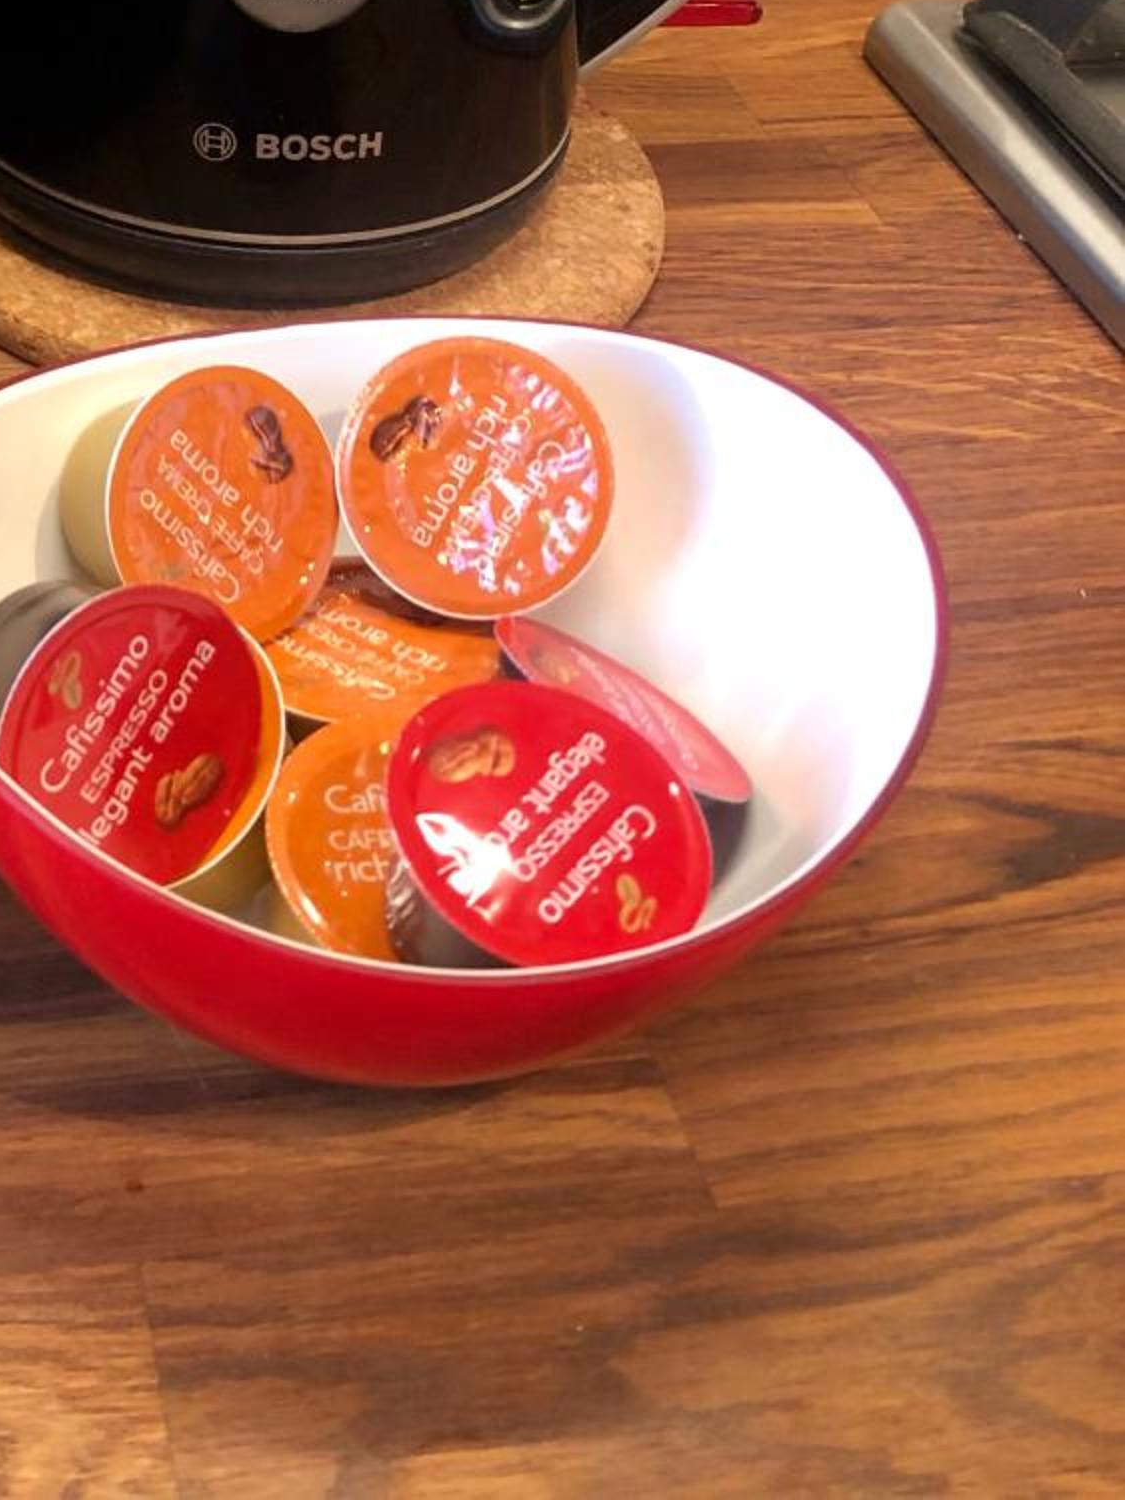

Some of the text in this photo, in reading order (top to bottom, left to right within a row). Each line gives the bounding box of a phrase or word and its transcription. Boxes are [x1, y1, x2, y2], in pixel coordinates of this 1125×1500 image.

[255, 132, 384, 161] BOSCH
[170, 429, 284, 553] rich aroma
[412, 395, 510, 548] rich aroma
[139, 488, 241, 604] Cafissimo
[40, 635, 150, 792] Cafissimo
[77, 640, 216, 846] legant aroma
[80, 669, 169, 805] ESPRESSO
[521, 732, 607, 815] elegant
[512, 781, 610, 882] ESPRESSO
[538, 804, 657, 924] Cafissimo
